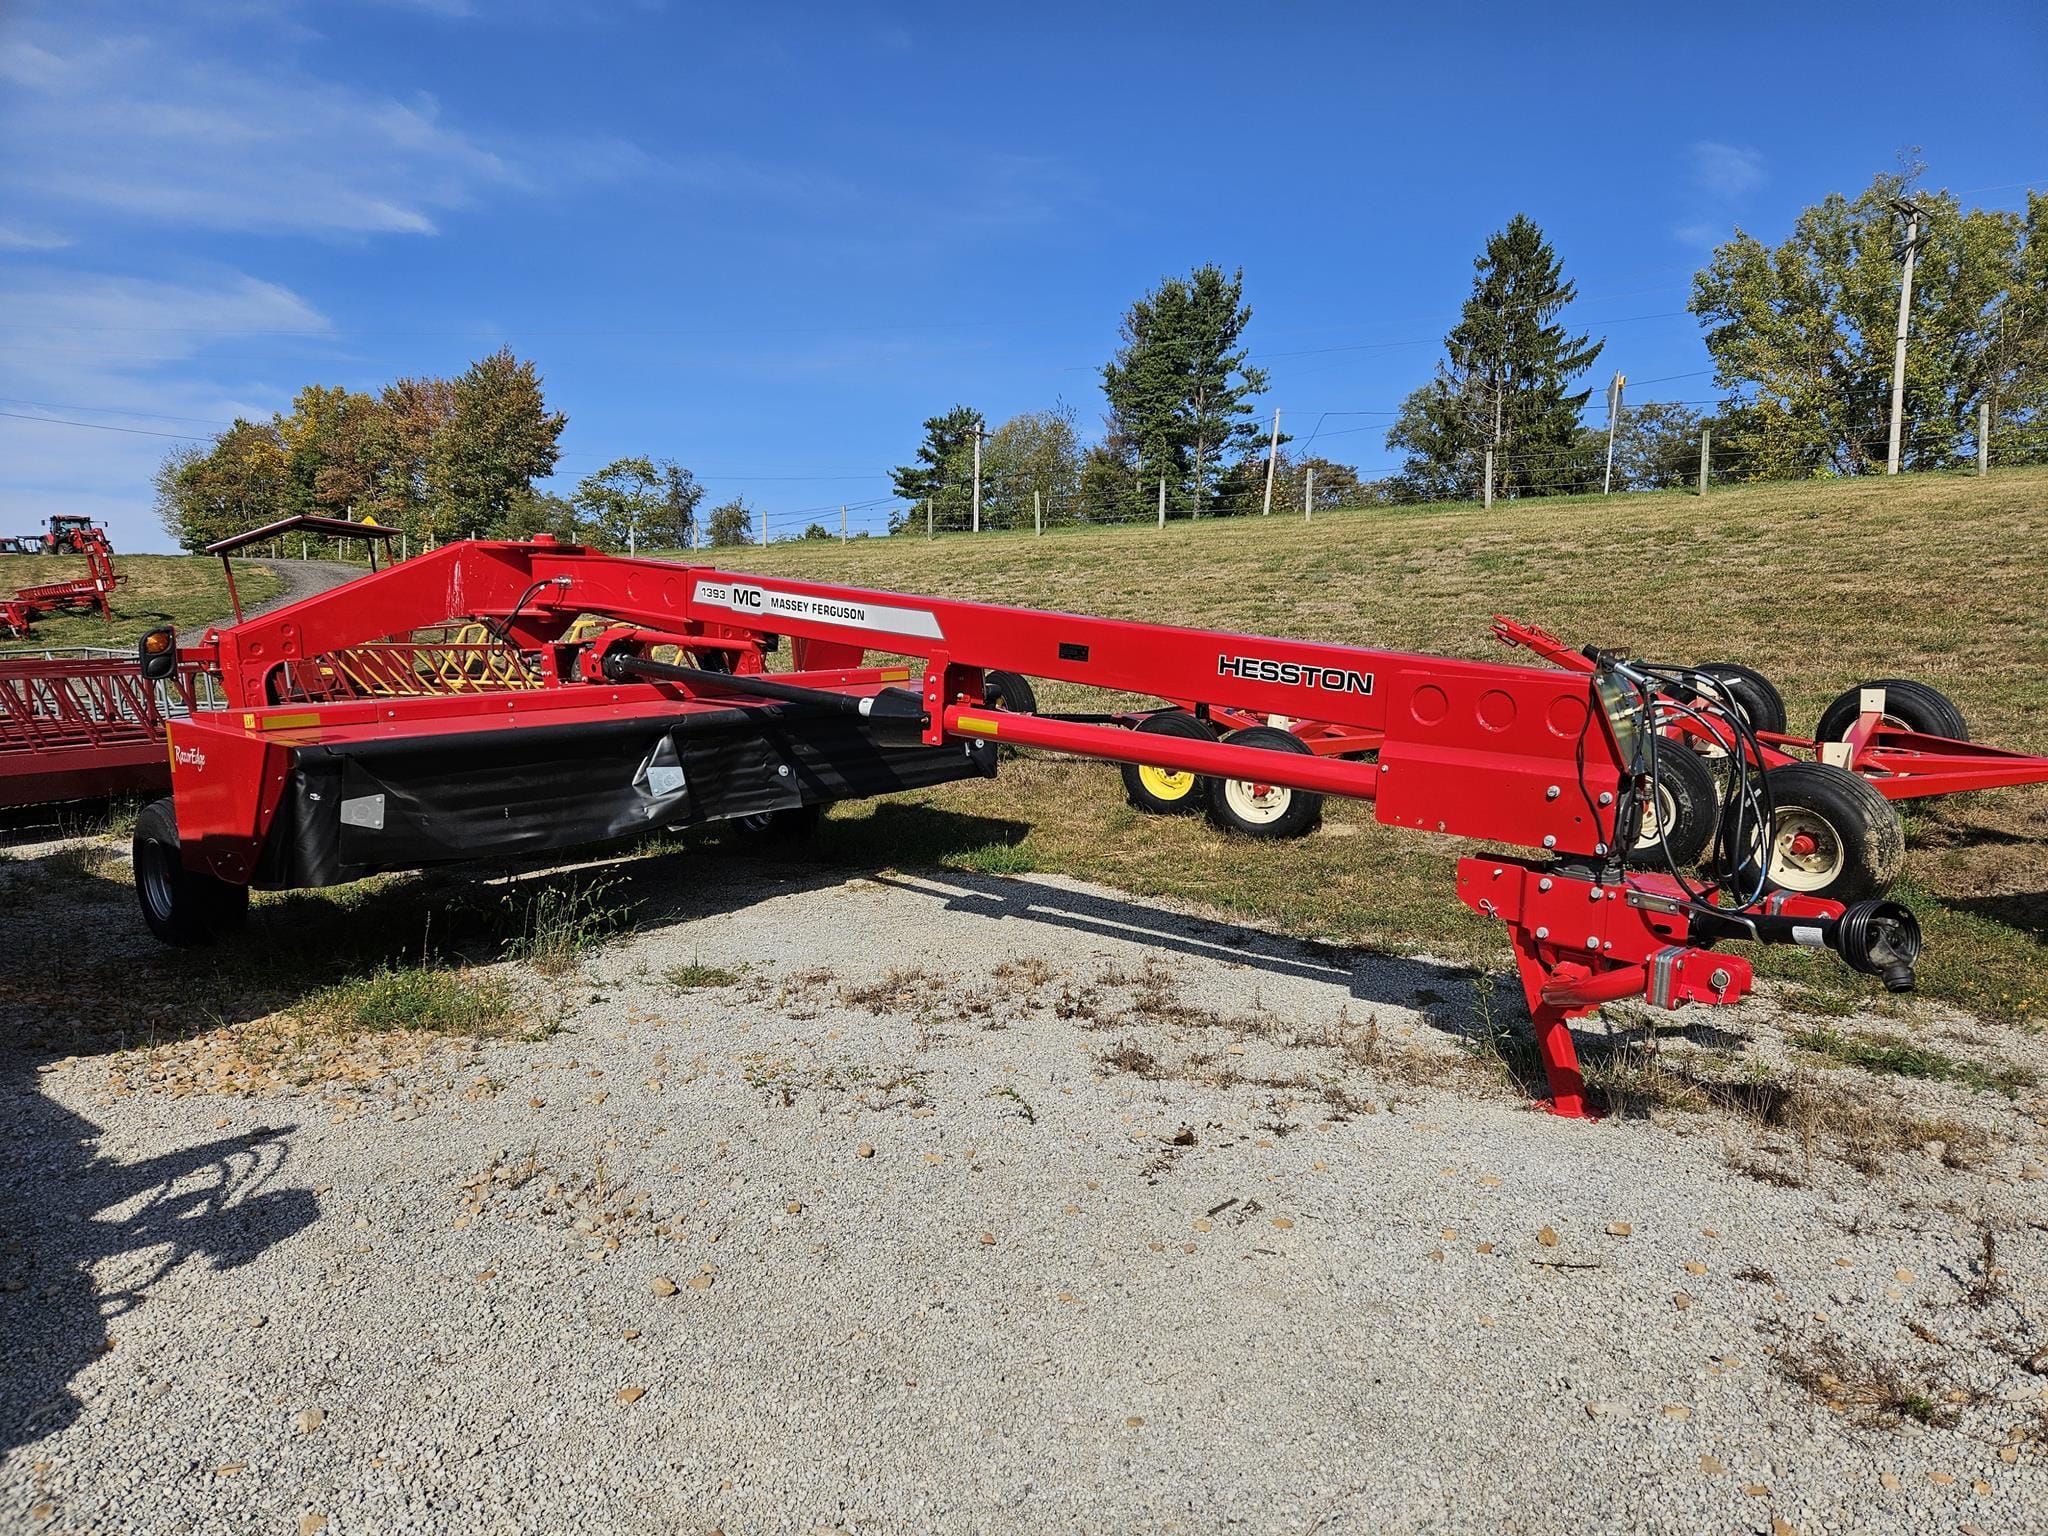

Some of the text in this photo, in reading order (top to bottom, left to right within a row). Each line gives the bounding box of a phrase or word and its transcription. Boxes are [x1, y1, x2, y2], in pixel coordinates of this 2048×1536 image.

[701, 587, 865, 621] 1393 MC MASSEY FERGUSON
[1218, 655, 1374, 695] HESSTON
